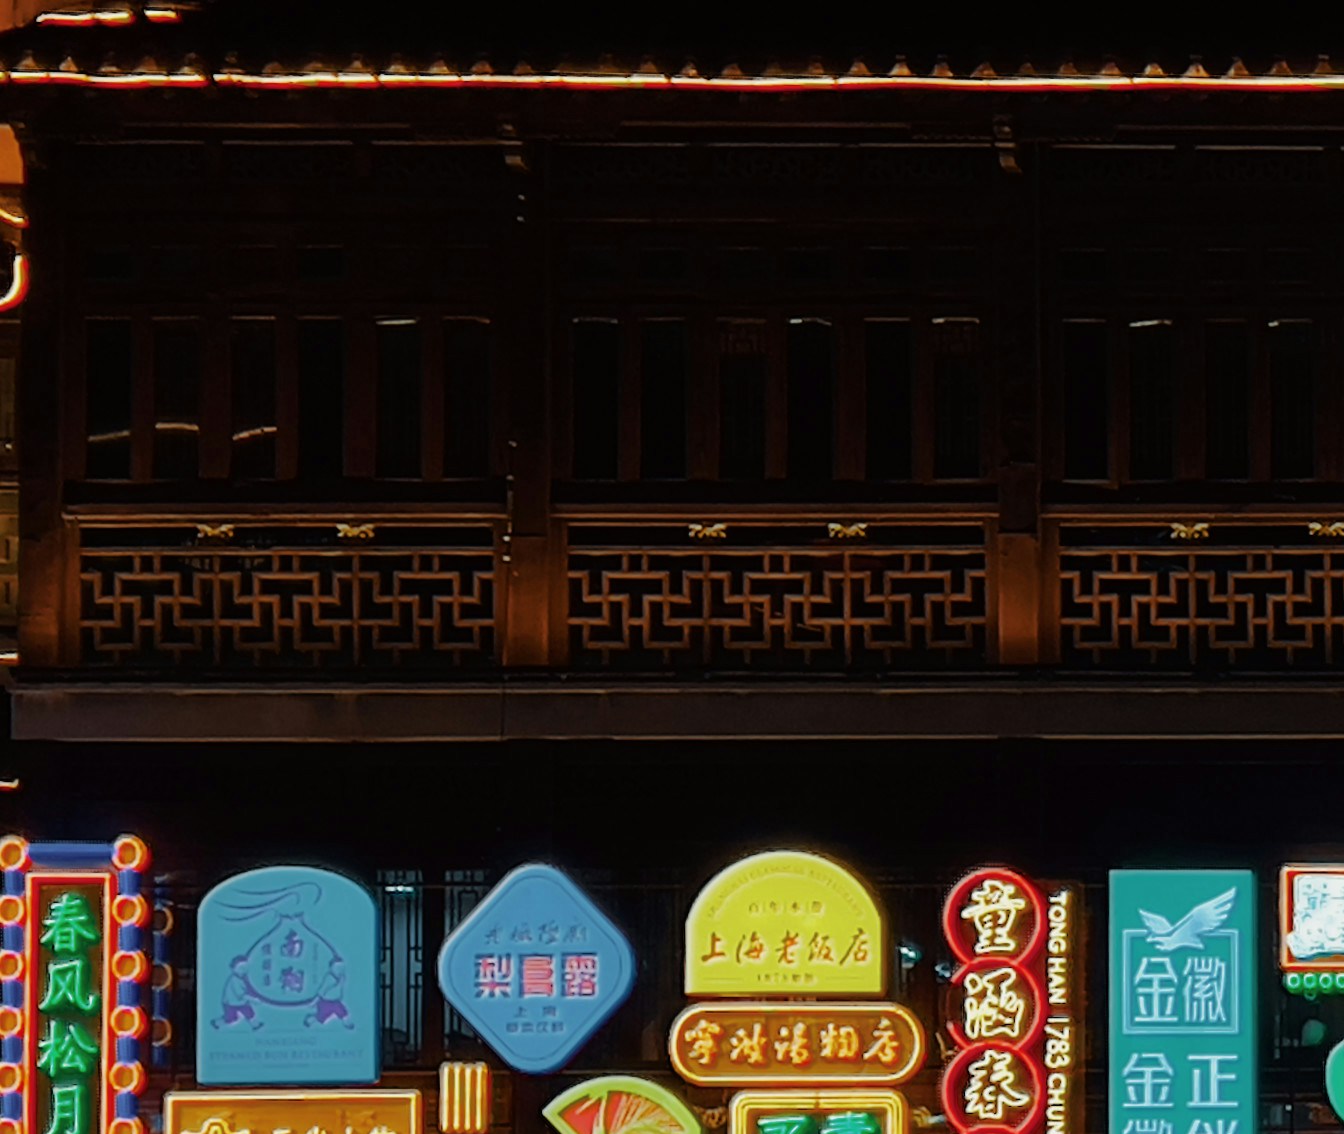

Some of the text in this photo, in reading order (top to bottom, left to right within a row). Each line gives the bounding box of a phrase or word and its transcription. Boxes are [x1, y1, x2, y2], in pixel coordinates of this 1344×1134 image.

[701, 928, 871, 967] 上海老饭店
[1048, 890, 1069, 953] TONG
[1047, 957, 1067, 1004] HAN
[1134, 957, 1228, 1024] 金徽
